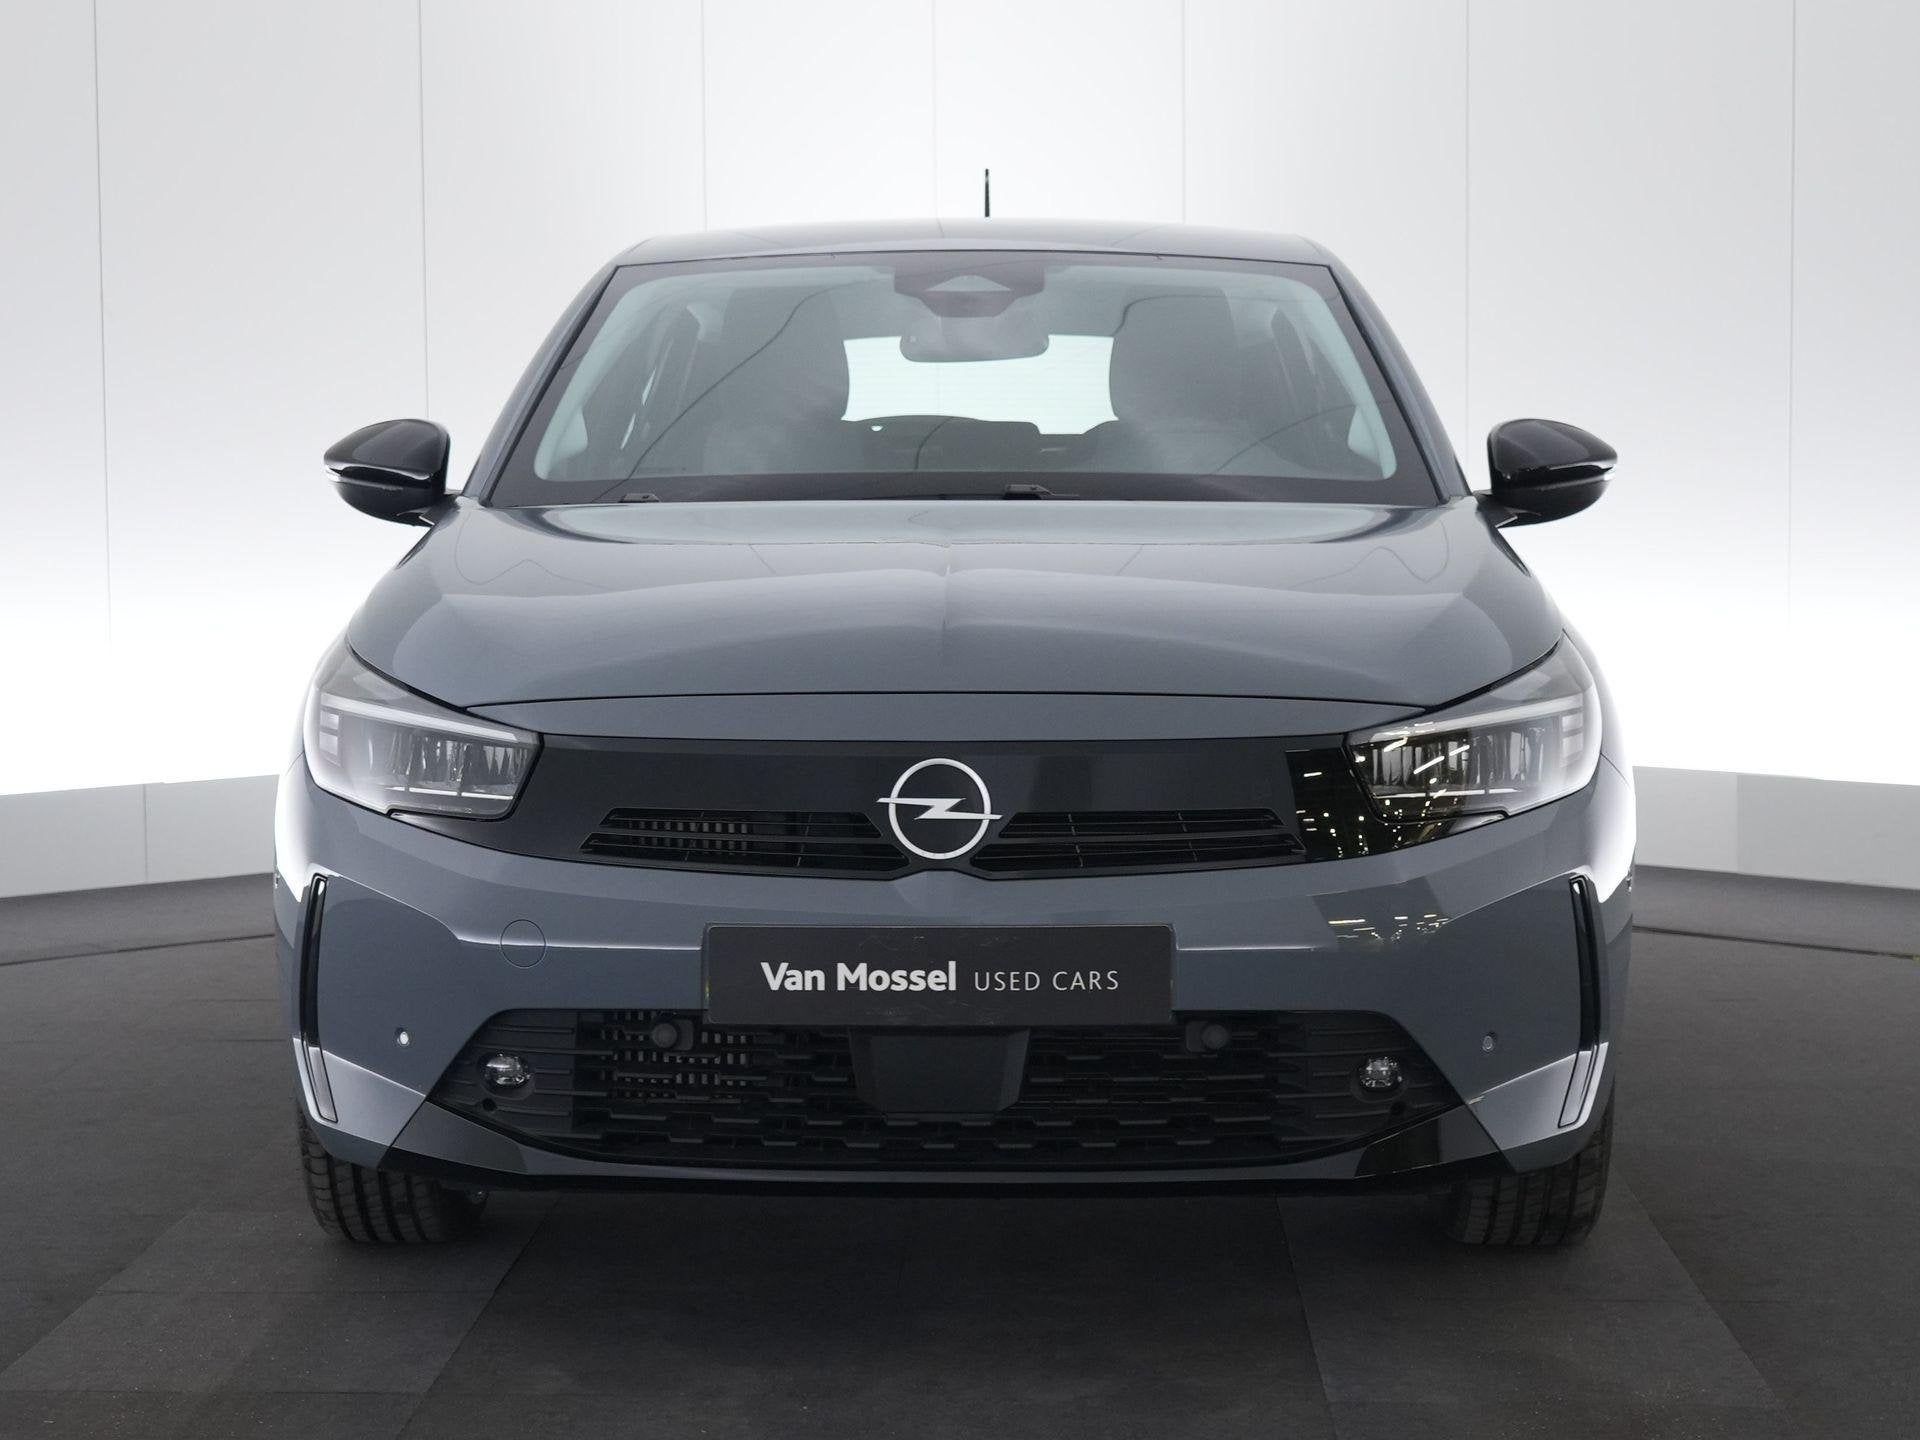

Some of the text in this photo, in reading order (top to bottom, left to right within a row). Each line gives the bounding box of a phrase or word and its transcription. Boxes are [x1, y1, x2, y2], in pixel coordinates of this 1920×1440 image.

[760, 960, 1119, 991] Van Mossel USED CARS
